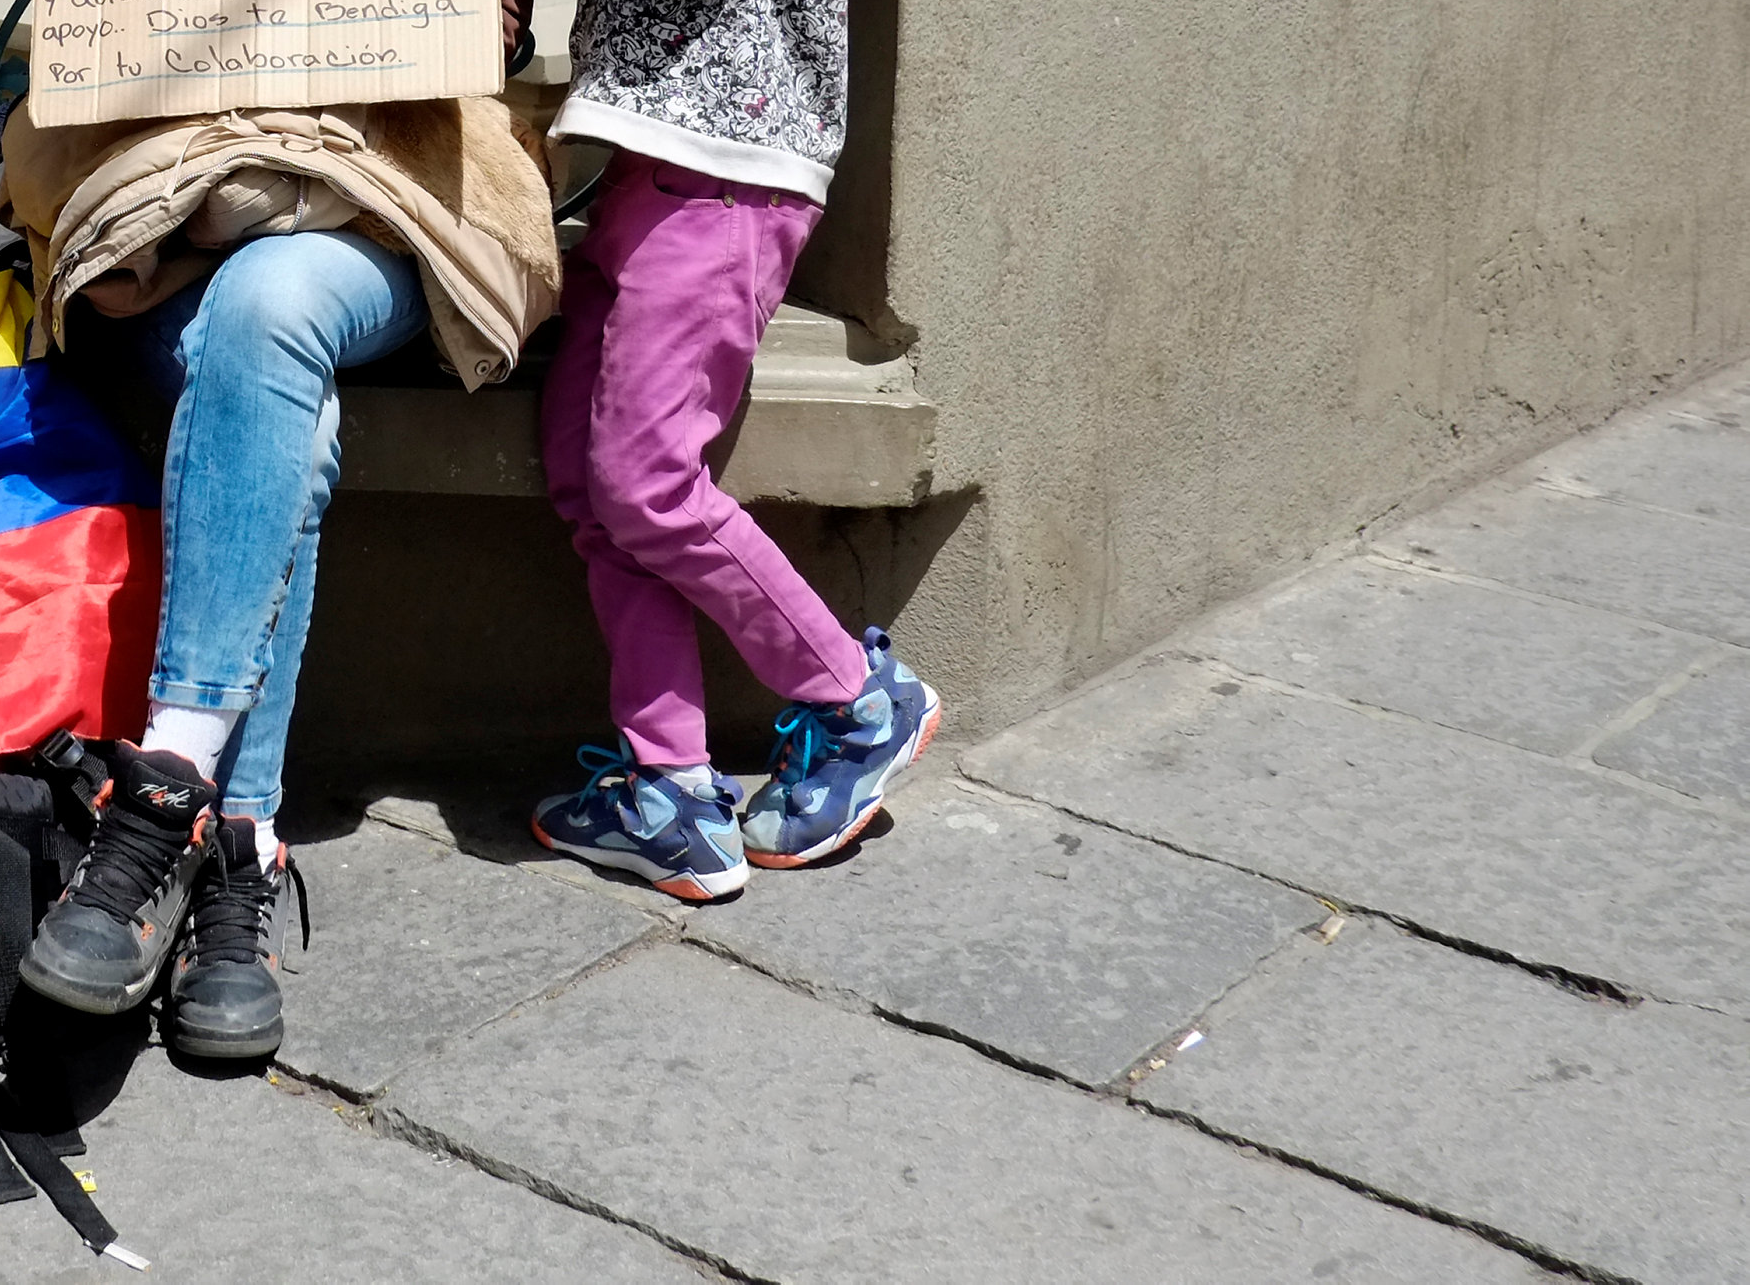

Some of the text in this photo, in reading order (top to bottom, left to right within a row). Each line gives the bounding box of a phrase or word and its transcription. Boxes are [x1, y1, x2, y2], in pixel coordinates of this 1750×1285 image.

[146, 8, 229, 32] Dios
[246, 2, 287, 26] te
[48, 62, 91, 84] Por
[116, 51, 142, 77] tu
